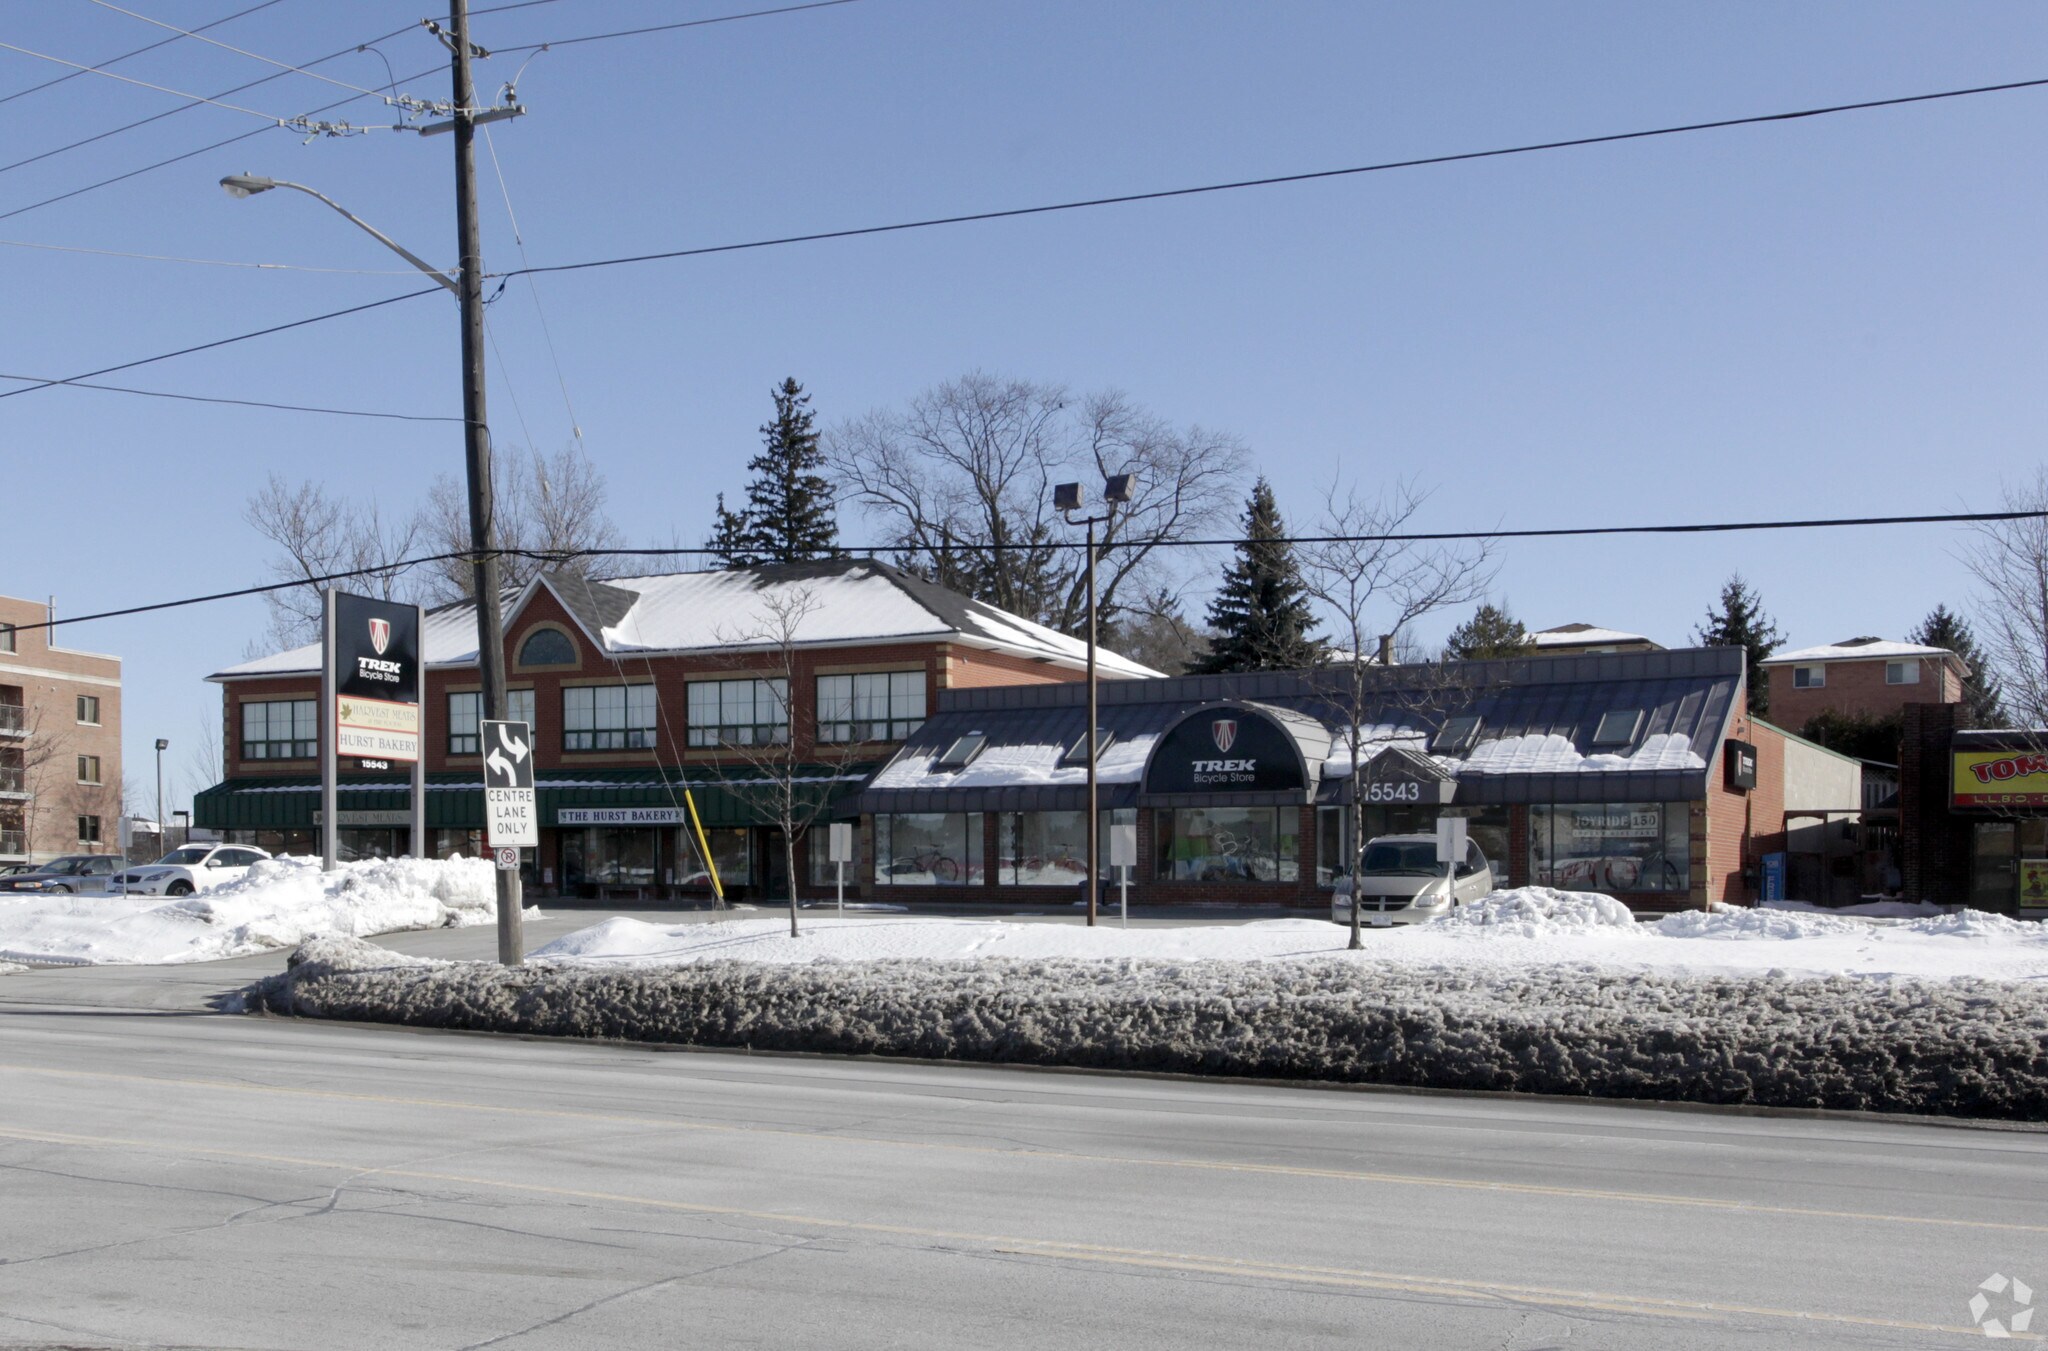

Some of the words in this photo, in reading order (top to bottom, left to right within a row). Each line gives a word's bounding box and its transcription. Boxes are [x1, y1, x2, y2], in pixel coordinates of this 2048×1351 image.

[358, 657, 401, 673] TREK
[359, 668, 384, 680] Bicycle
[384, 672, 400, 683] Store
[353, 704, 390, 718] HARVEST
[392, 709, 416, 721] MEATS
[340, 733, 375, 748] HURST
[379, 737, 417, 752] BAKERY
[361, 760, 388, 770] 15543
[1191, 759, 1256, 772] TREK
[1193, 774, 1228, 784] Bicycle
[1230, 773, 1255, 782] Store
[489, 790, 532, 802] CENTRE
[497, 806, 527, 818] LANE
[568, 811, 588, 821] THE
[593, 811, 627, 821] HURST
[632, 810, 673, 821] BAKERY
[1575, 815, 1629, 827] JOYRIDE
[1632, 815, 1656, 826] 150
[497, 822, 527, 834] ONLY
